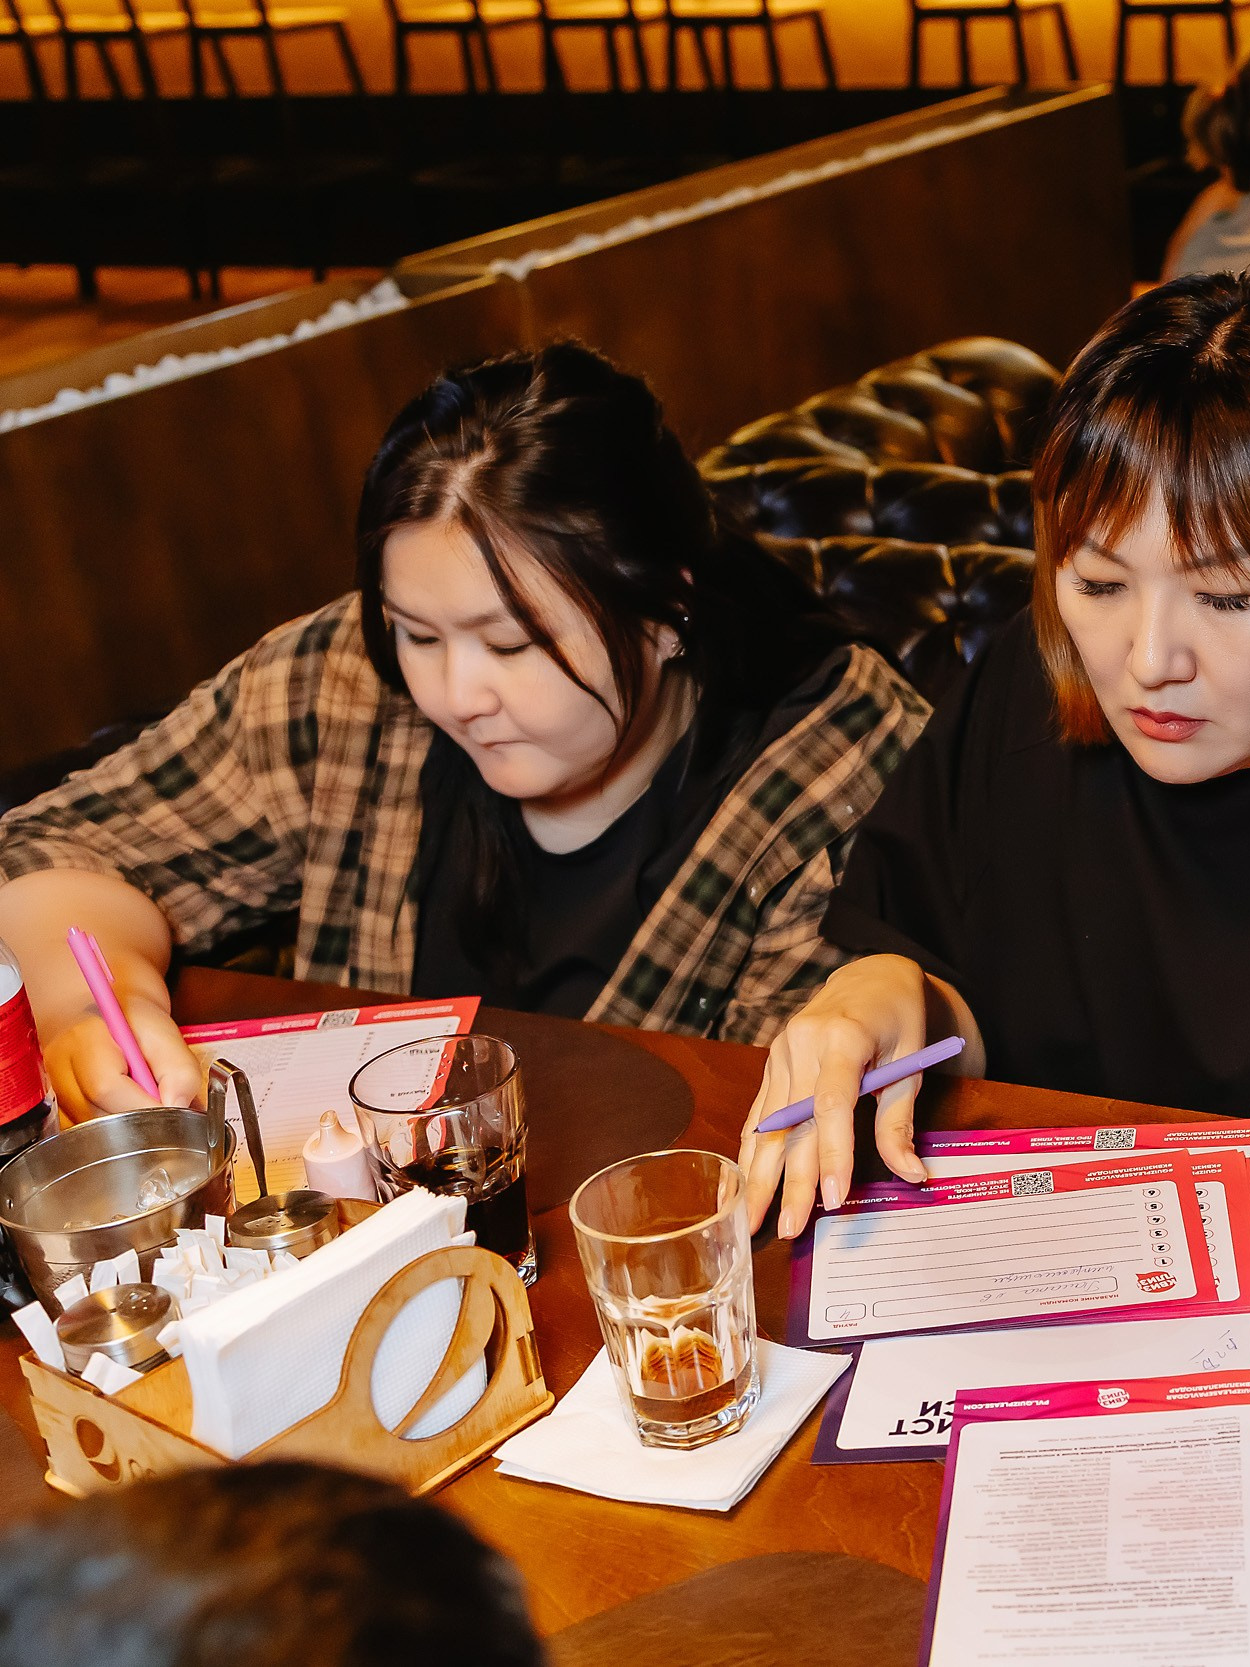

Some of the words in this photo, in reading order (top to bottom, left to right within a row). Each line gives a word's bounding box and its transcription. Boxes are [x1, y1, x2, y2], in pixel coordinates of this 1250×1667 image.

[932, 1140, 1010, 1148] PVL.QUIZPLEASE.COM
[1084, 1168, 1174, 1182] #QUIZPLEASEPAVLODAR
[920, 1184, 962, 1192] СМОТРЕТЬ
[948, 1190, 998, 1200] СКАНИРУЙТЕ
[1039, 1298, 1079, 1306] КОМАНДЫ
[1080, 1294, 1119, 1302] НАЗВАНИЕ
[964, 1400, 1050, 1410] PVL.QUIZPLEASE.COM
